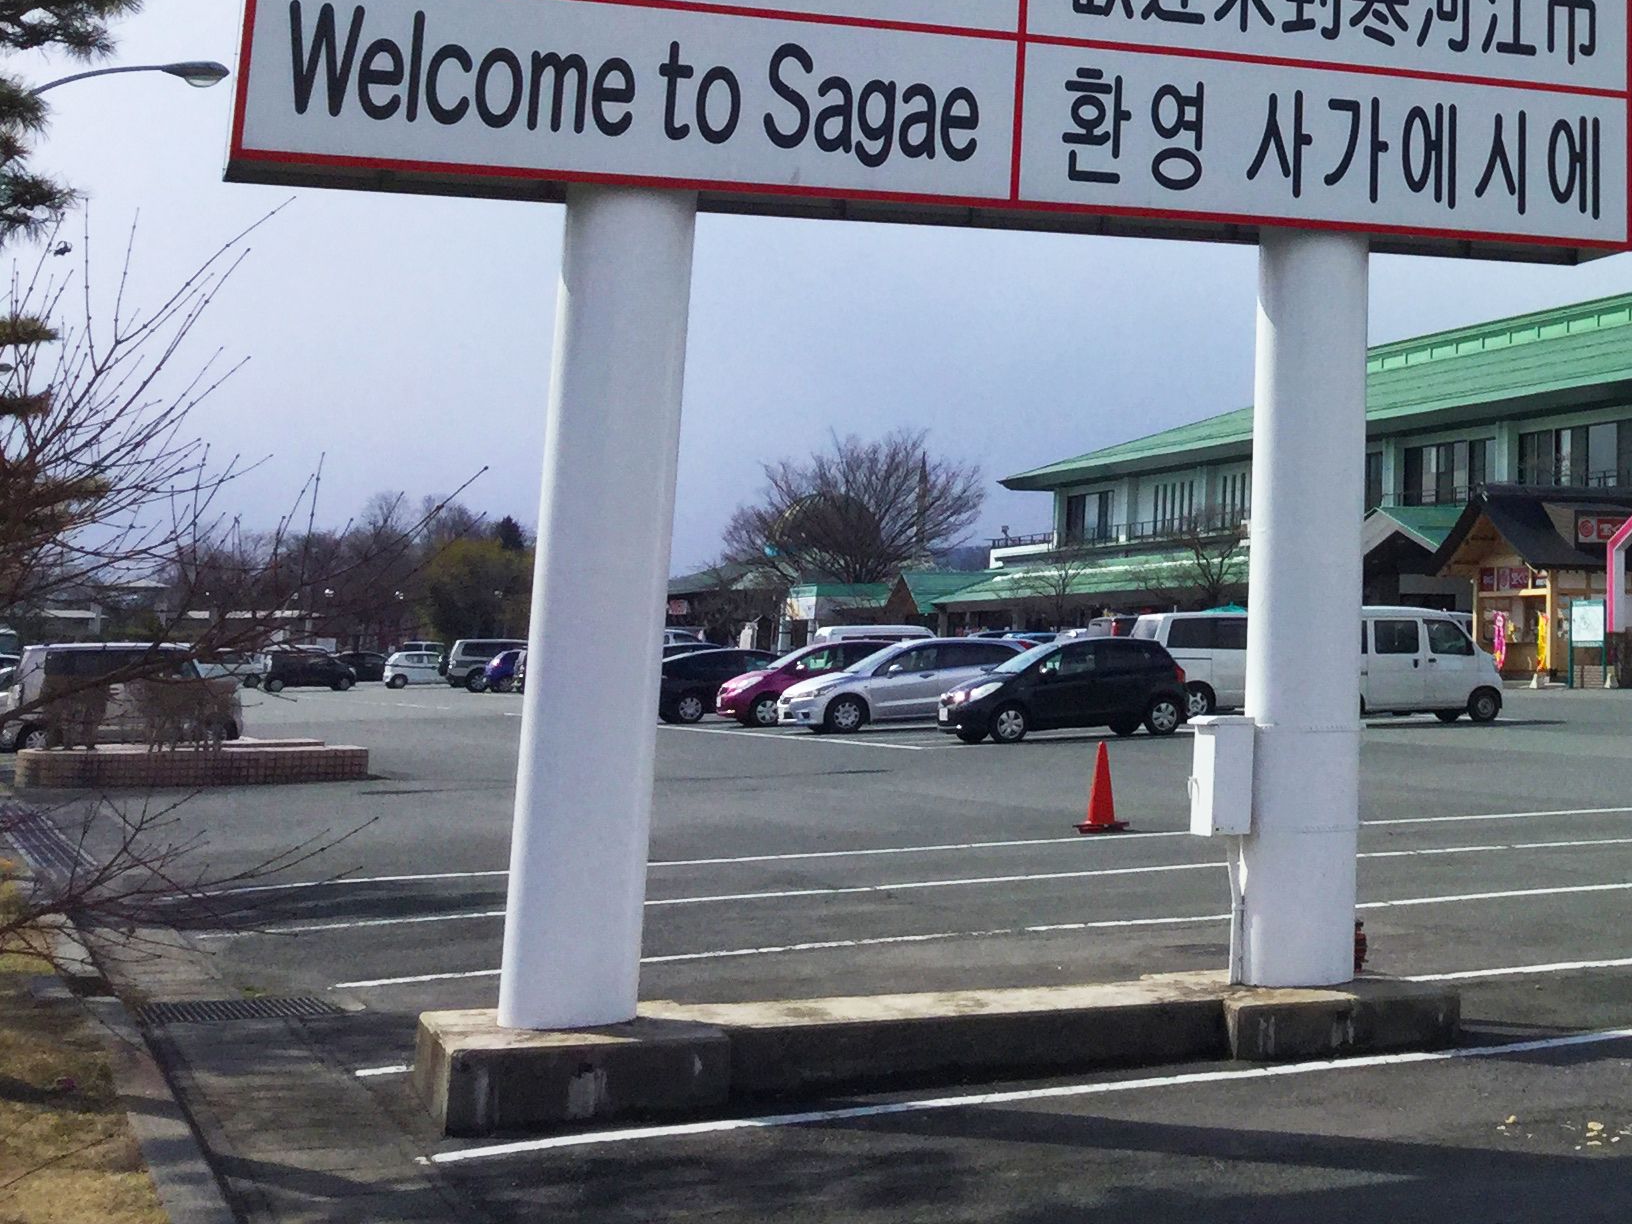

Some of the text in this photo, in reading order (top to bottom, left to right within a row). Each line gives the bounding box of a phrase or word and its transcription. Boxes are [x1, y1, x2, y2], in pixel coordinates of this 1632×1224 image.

[289, 0, 980, 168] Welcome to Sagae
[1062, 67, 1204, 191] 환영
